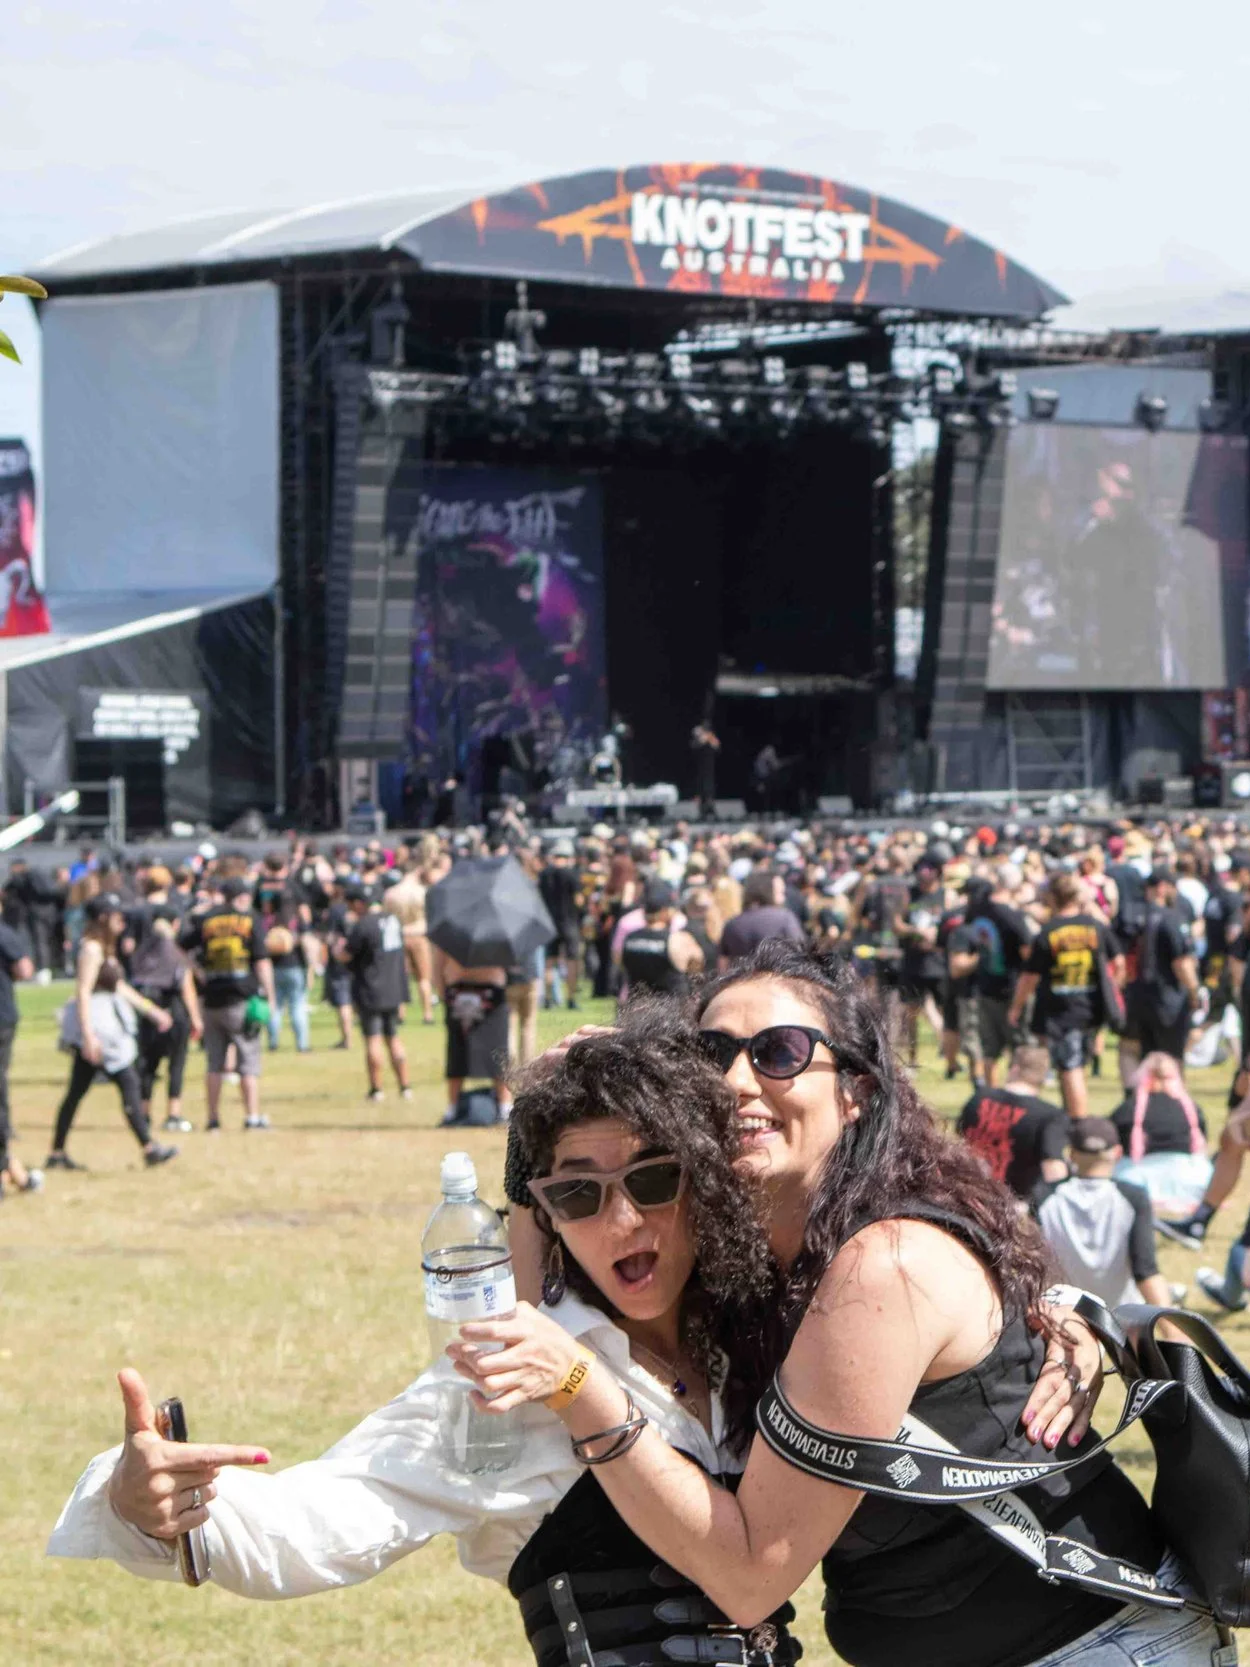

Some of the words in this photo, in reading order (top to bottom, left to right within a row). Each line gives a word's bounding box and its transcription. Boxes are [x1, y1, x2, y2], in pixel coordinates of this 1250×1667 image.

[631, 192, 870, 262] KNOTFEST
[660, 248, 845, 284] AUSTRALIA
[766, 1399, 858, 1470] STEVEMADDEN
[942, 1466, 1050, 1488] STEVEMADDEN
